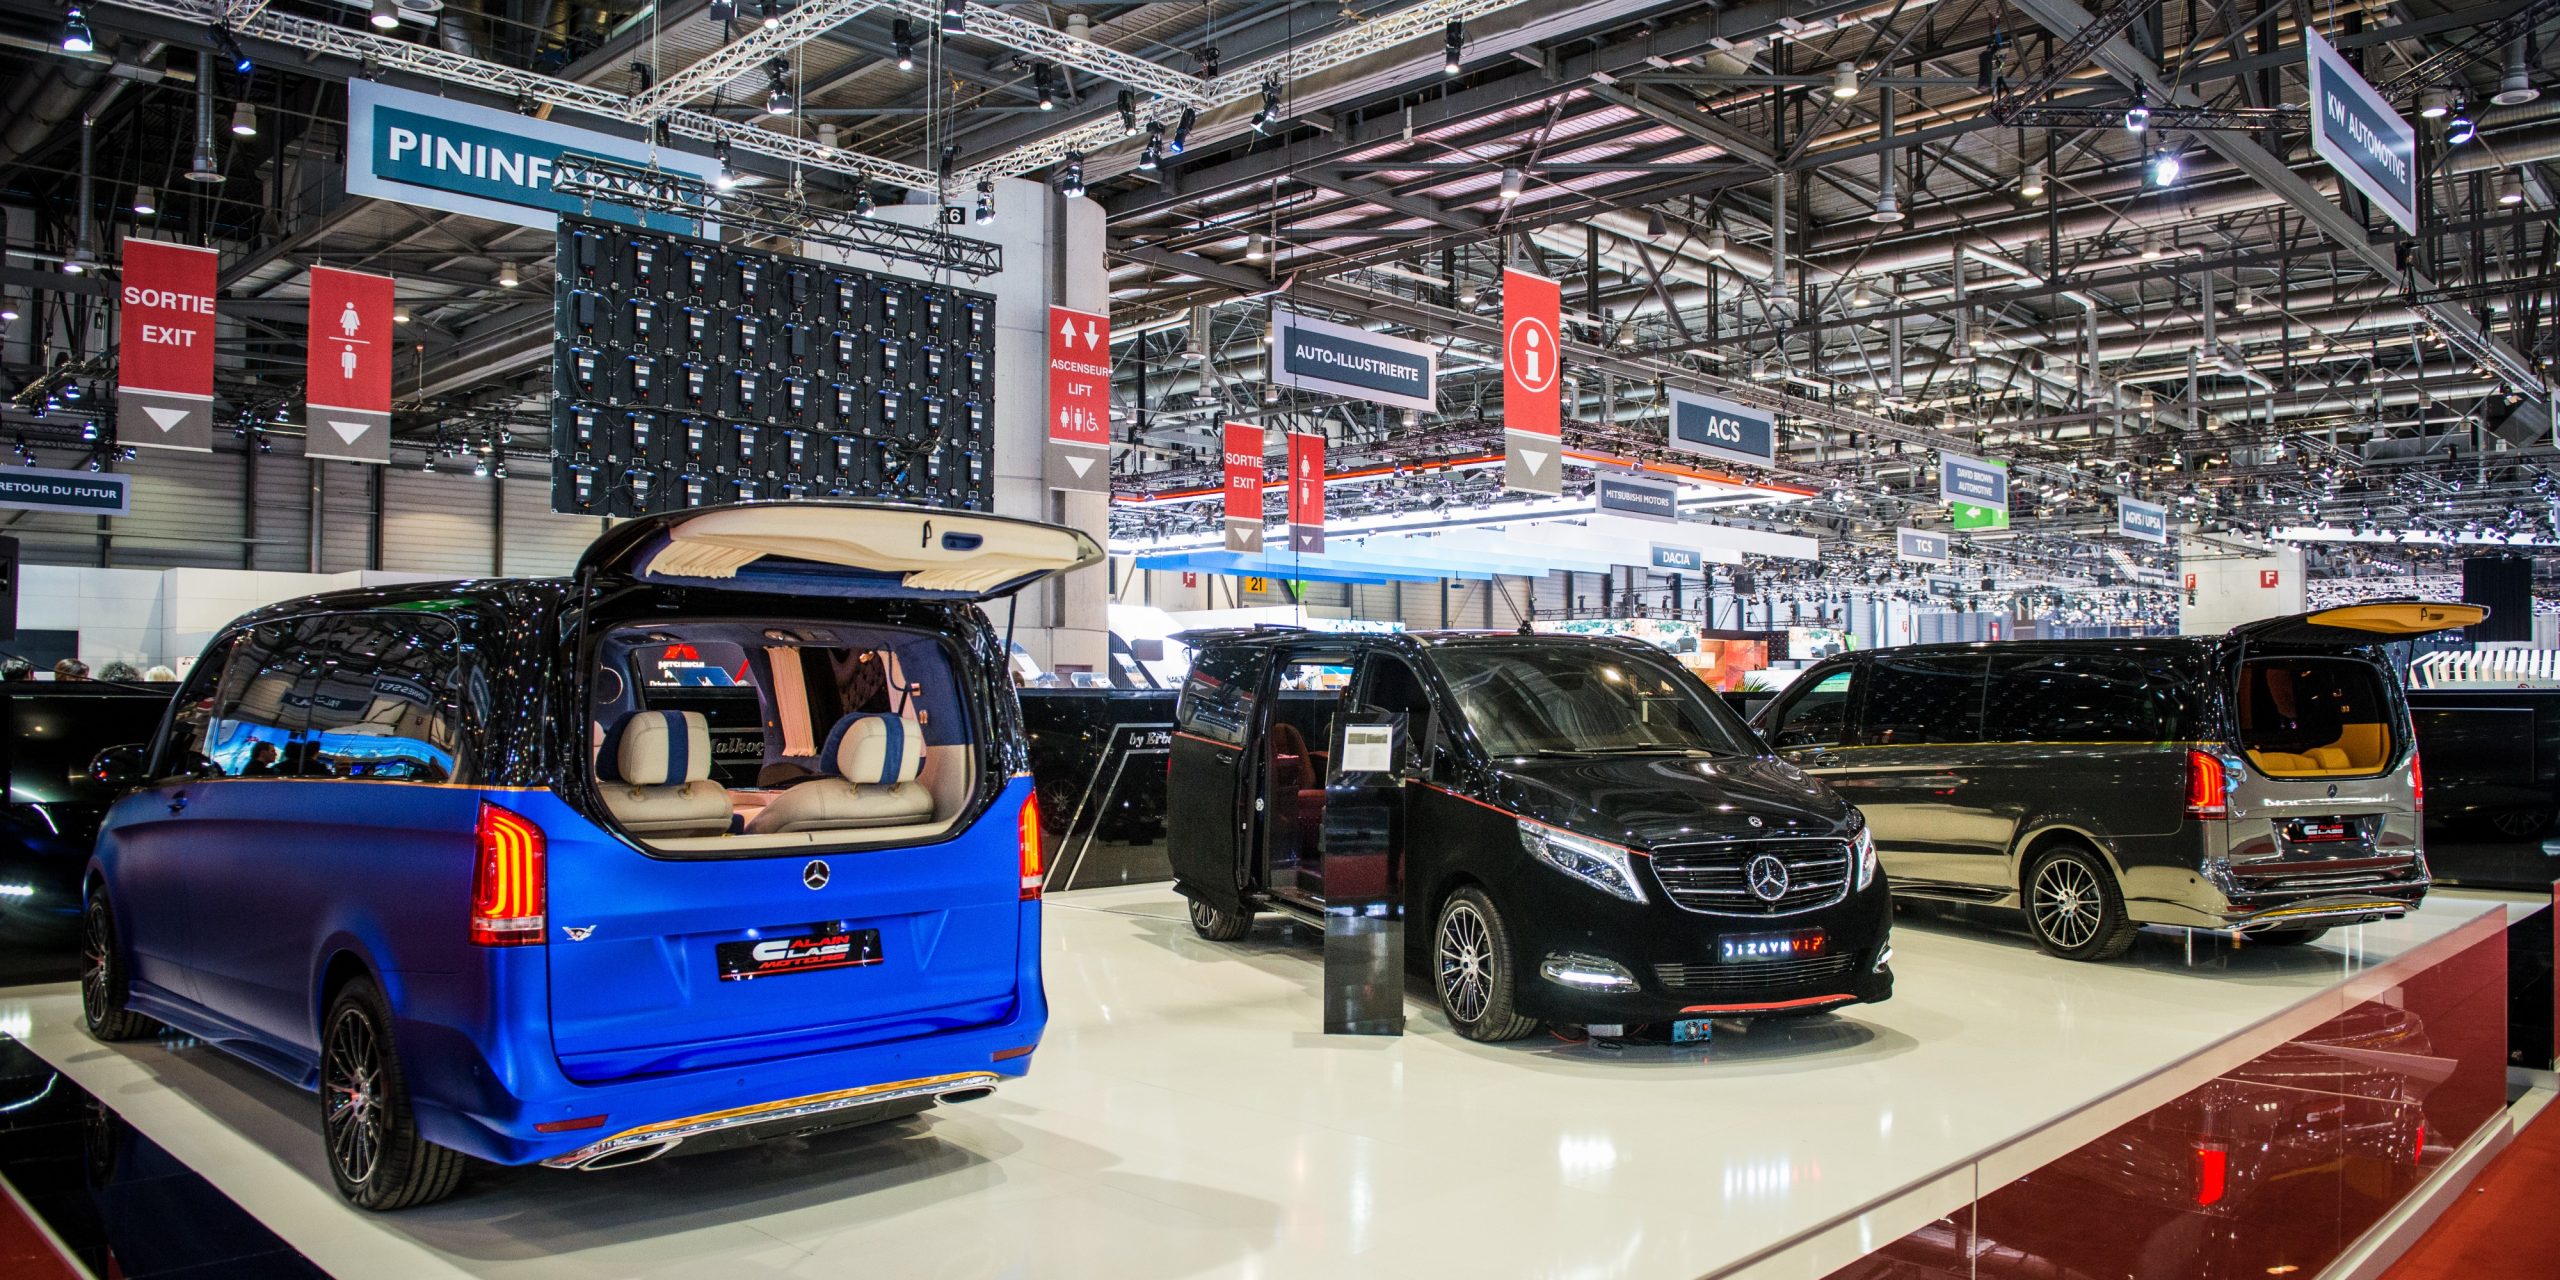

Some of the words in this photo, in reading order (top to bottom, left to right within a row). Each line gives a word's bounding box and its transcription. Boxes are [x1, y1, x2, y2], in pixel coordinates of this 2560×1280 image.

[2327, 90, 2345, 127] KW
[2349, 112, 2406, 184] AUTOMOTIVE
[124, 286, 215, 315] SORTIE
[142, 324, 197, 347] EXIT
[1051, 358, 1109, 377] ASCENSEUR
[1295, 344, 1419, 382] AUTO-ILLUSTRIERTE
[1068, 382, 1093, 397] LIFT
[1706, 415, 1741, 443] ACS
[1225, 452, 1263, 469] SORTIE
[1956, 467, 1973, 480] DAVID
[1233, 476, 1256, 490] EXIT
[52, 486, 72, 495] DU
[75, 487, 117, 499] FUTUR
[1606, 489, 1643, 503] MITSUBISHI
[1643, 494, 1669, 507] MOTORS
[1915, 540, 1933, 553] TCS
[1662, 551, 1690, 566] DACIA
[1250, 576, 1263, 592] 21
[2266, 572, 2275, 585] F
[1129, 732, 1144, 748] by
[790, 935, 850, 949] ALAIN
